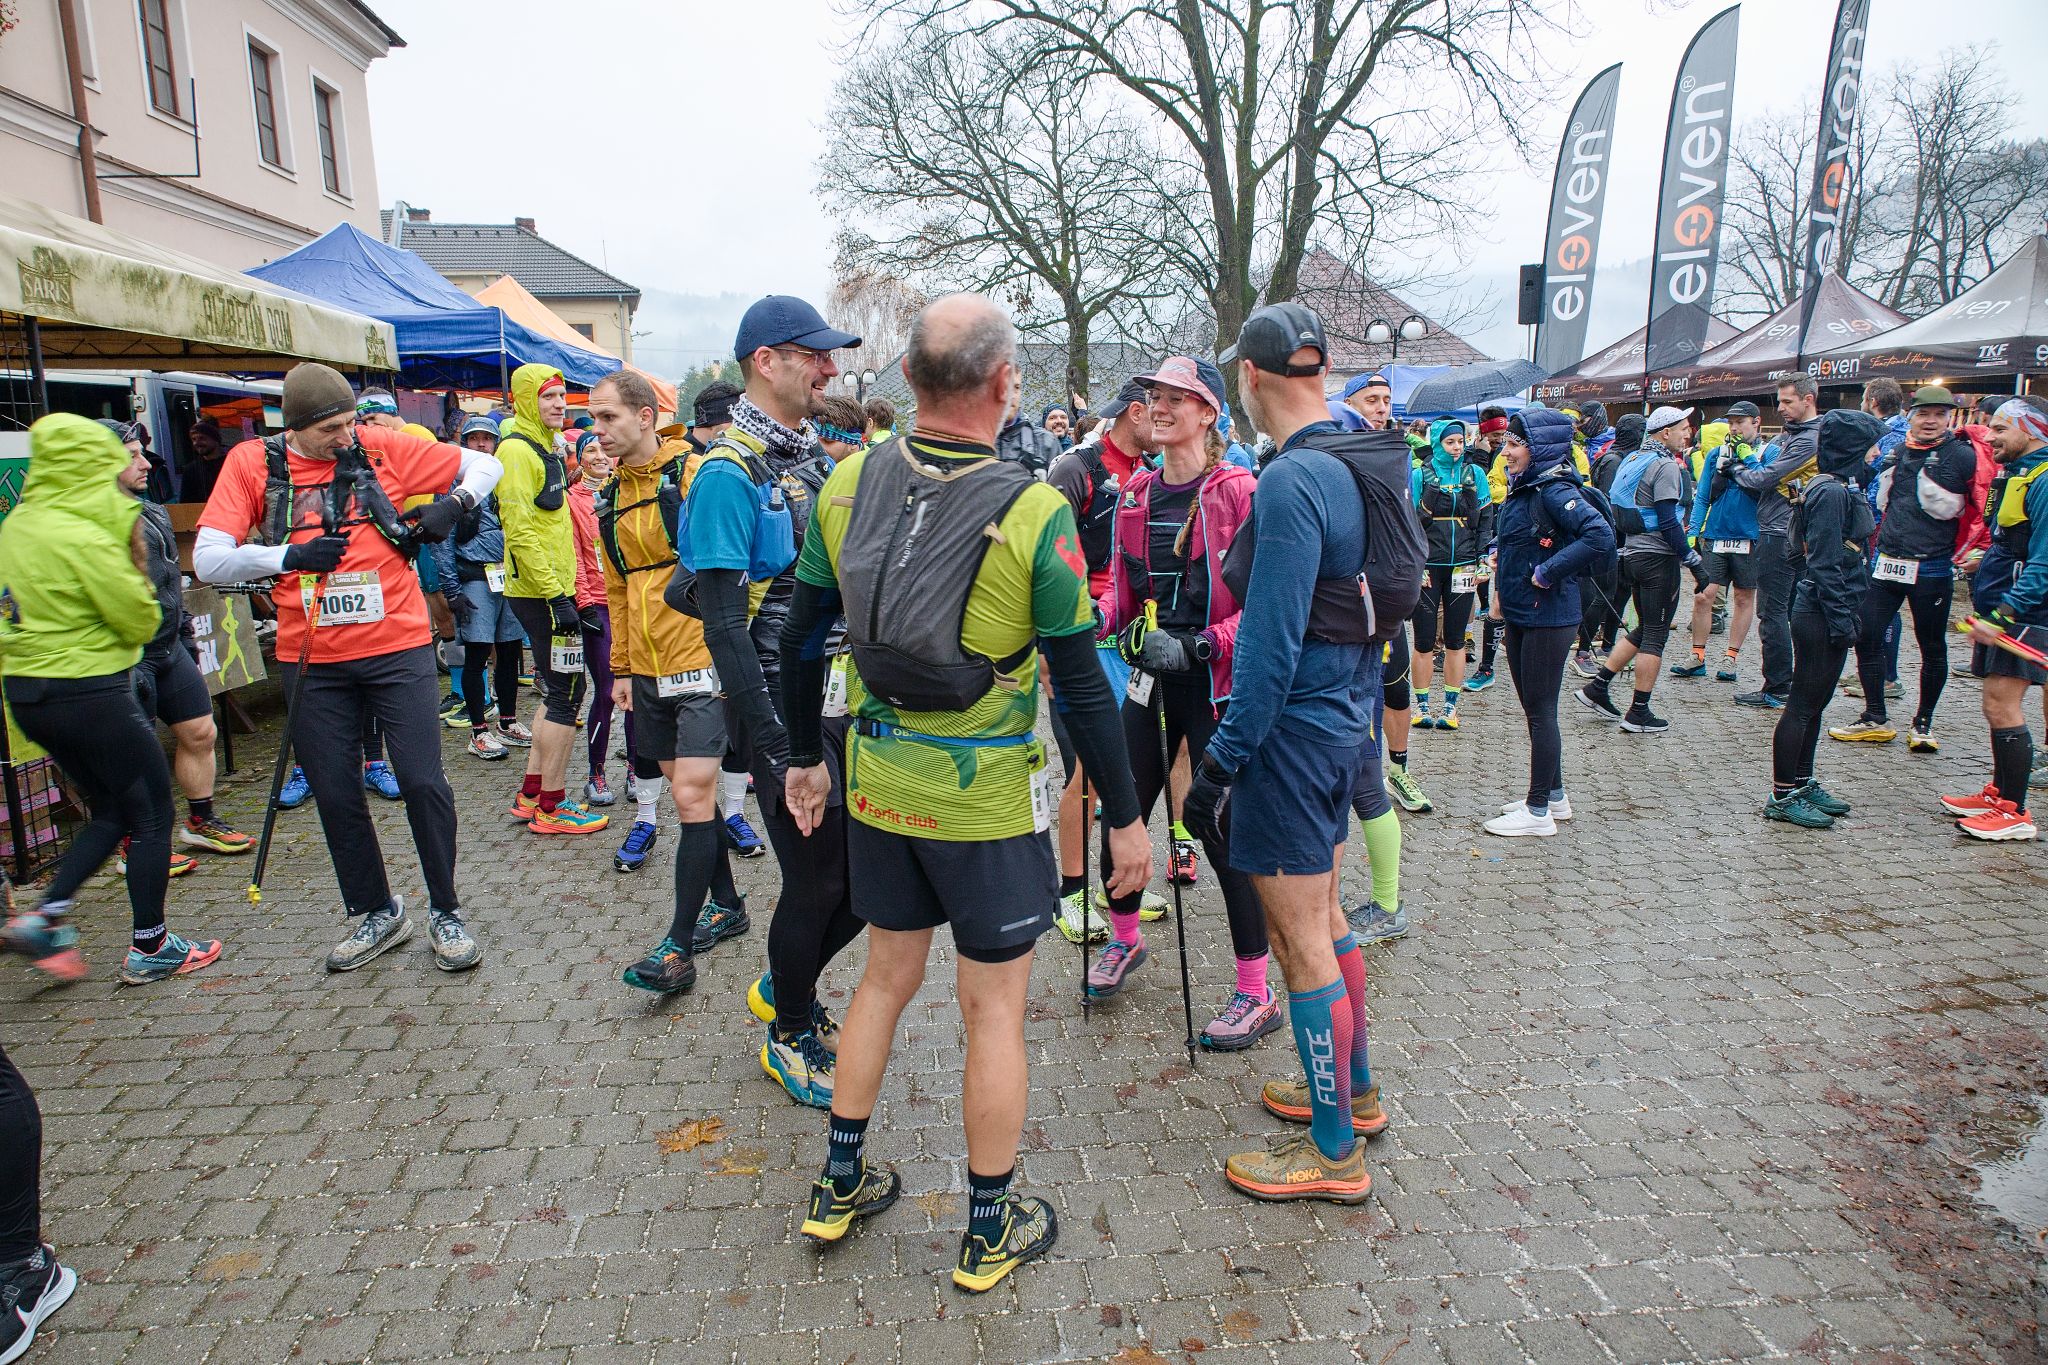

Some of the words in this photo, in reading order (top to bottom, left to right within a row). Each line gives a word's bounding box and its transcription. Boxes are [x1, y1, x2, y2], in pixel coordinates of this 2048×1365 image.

[1660, 81, 1727, 304] eleven
[1547, 129, 1607, 321] eleven
[1979, 343, 2009, 357] TKF
[1807, 358, 1860, 376] eleven
[1536, 385, 1565, 398] eleven
[1651, 377, 1689, 393] eleven
[899, 539, 914, 568] EVADICT
[1883, 562, 1907, 576] 1046
[322, 594, 367, 615] 1062
[867, 804, 902, 825] Forfit
[905, 815, 938, 830] club
[1306, 1027, 1337, 1107] FORCE
[1286, 1167, 1323, 1184] HOKA
